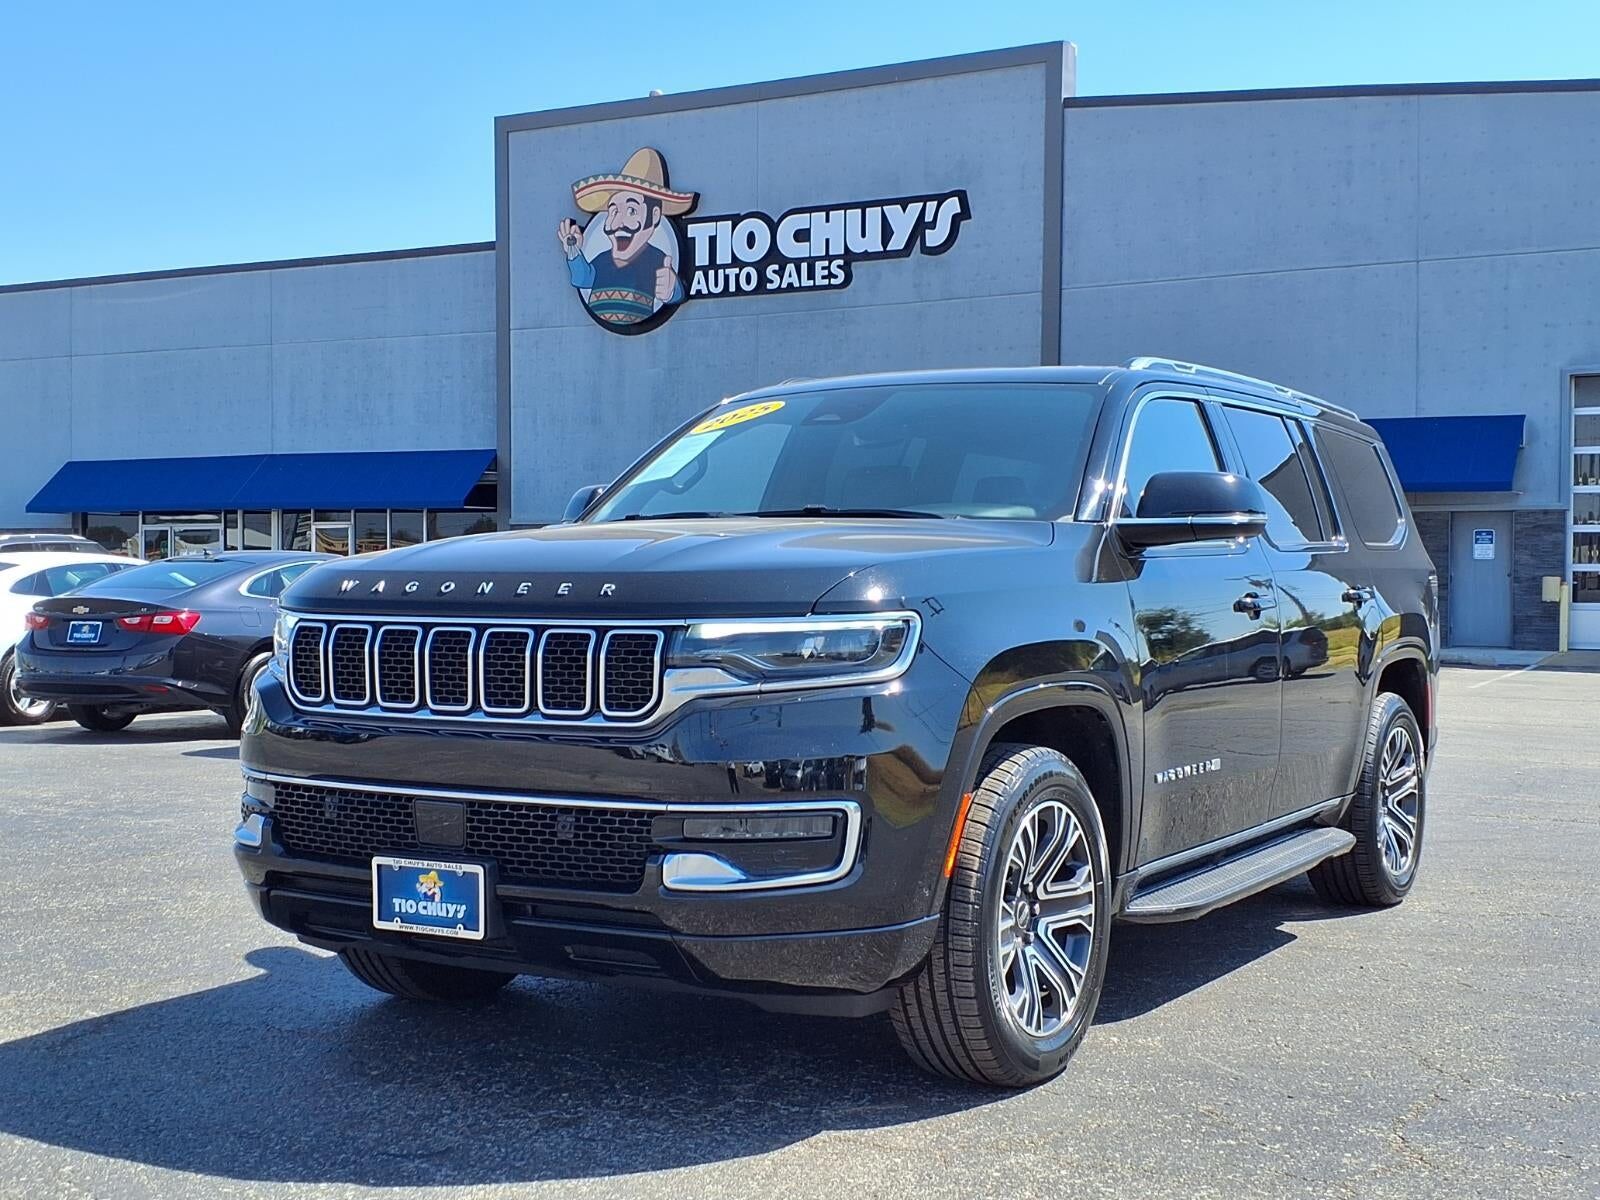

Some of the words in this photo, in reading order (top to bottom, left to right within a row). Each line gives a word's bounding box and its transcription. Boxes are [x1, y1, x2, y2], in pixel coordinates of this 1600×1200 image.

[687, 218, 771, 266] TIO
[776, 196, 961, 259] CHUY'S
[690, 268, 758, 295] AUTO
[766, 259, 846, 290] SALES
[340, 580, 616, 596] WAGONEER
[1156, 760, 1212, 783] WAGONEER
[443, 863, 463, 871] SALES
[392, 897, 417, 914] TIO
[417, 900, 467, 919] CHUY'S
